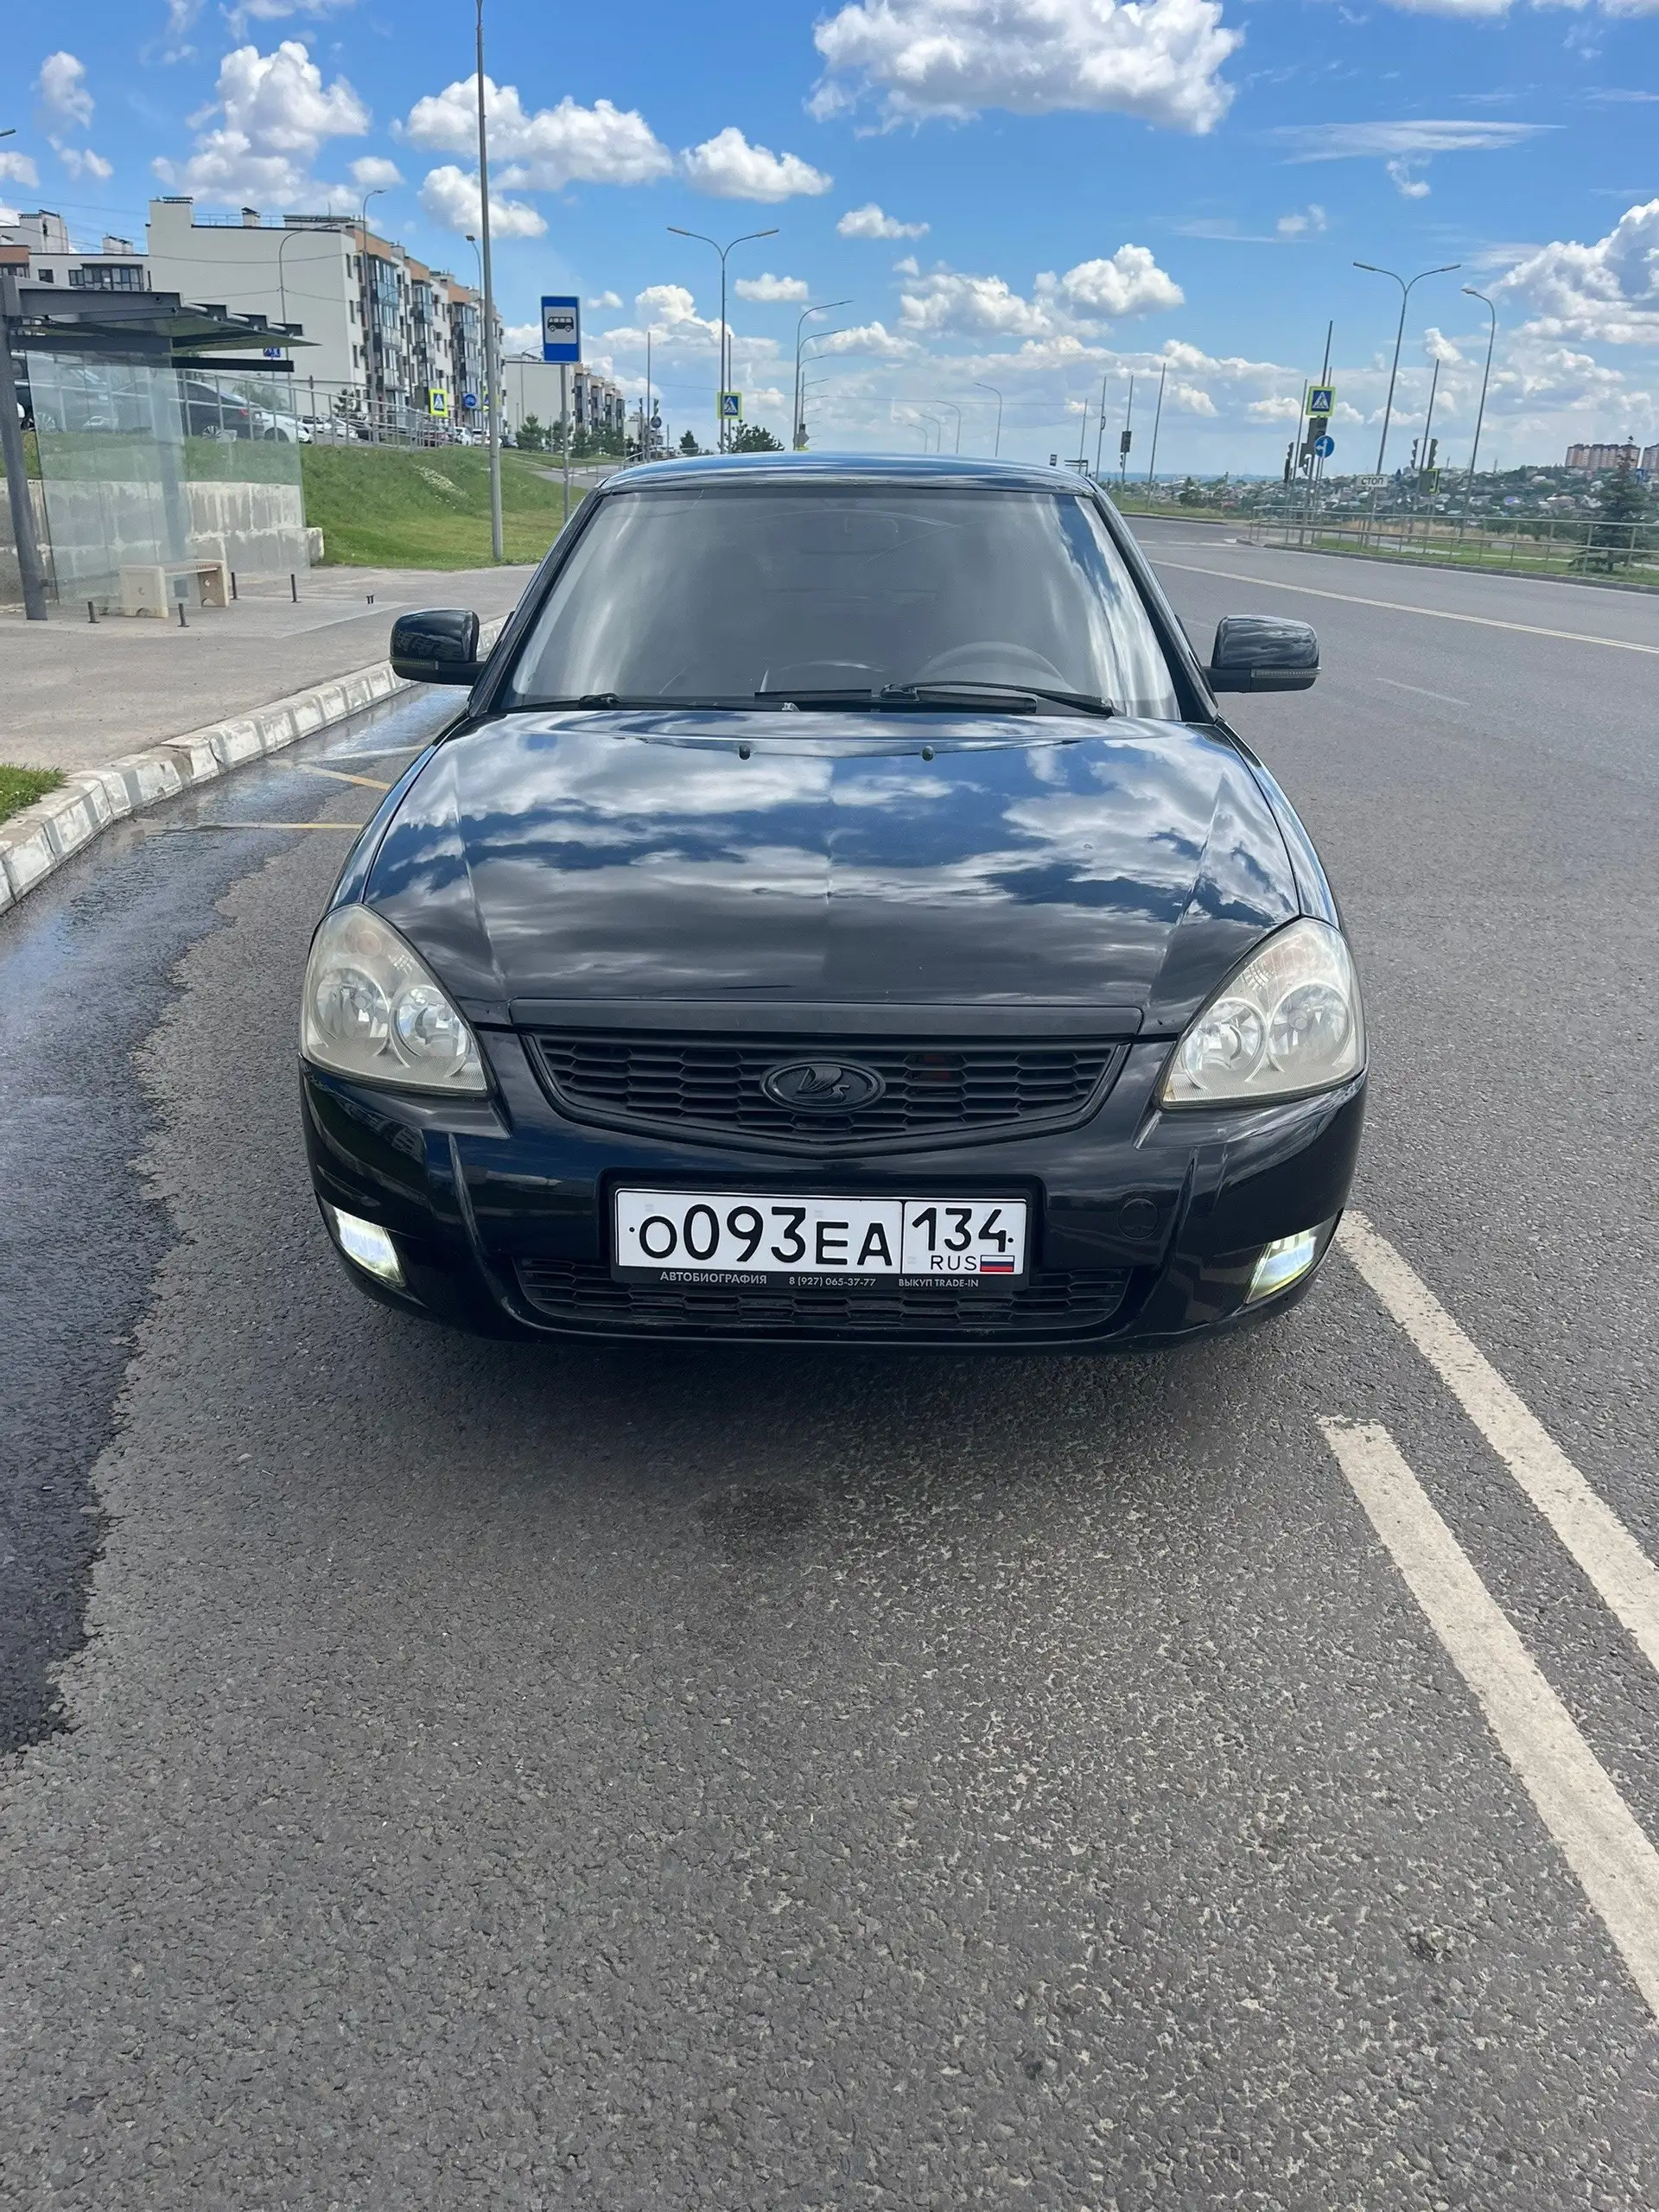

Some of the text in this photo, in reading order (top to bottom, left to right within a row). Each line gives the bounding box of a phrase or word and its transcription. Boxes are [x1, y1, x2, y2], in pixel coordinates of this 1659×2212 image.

[1361, 477, 1384, 486] СТОП
[912, 1206, 1007, 1253] 134
[930, 1255, 977, 1271] RUS
[659, 1271, 767, 1285] АВТОБИОГРАФИЯ
[788, 1275, 876, 1287] 8 (927) 065-37-77
[898, 1278, 979, 1288] ВЫКУП TRADE-IN
